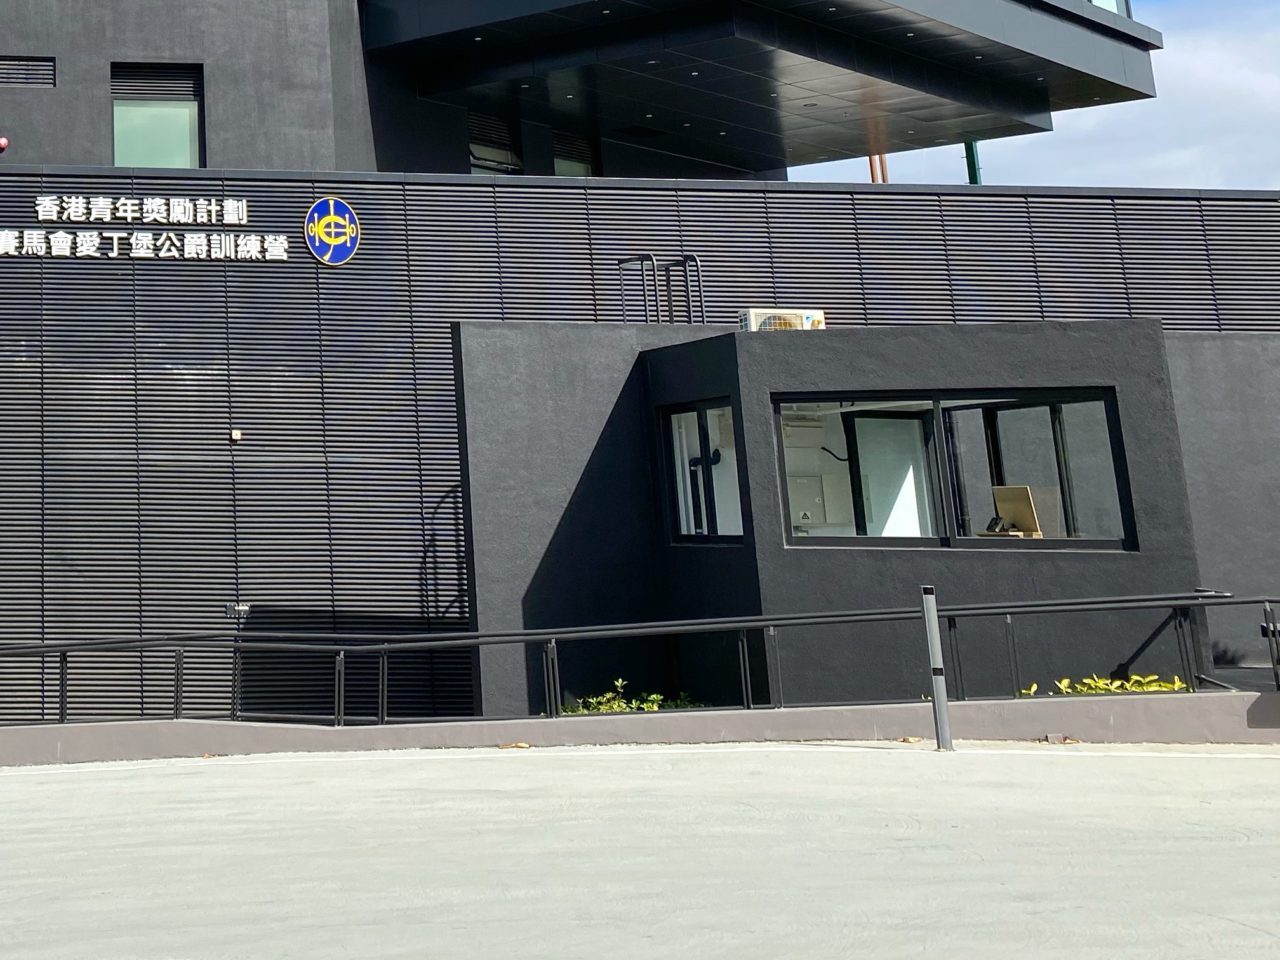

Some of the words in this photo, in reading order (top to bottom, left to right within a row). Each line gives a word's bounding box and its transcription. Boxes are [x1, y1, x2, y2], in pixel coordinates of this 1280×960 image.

[34, 195, 248, 224] 香港青年獎勵計劃
